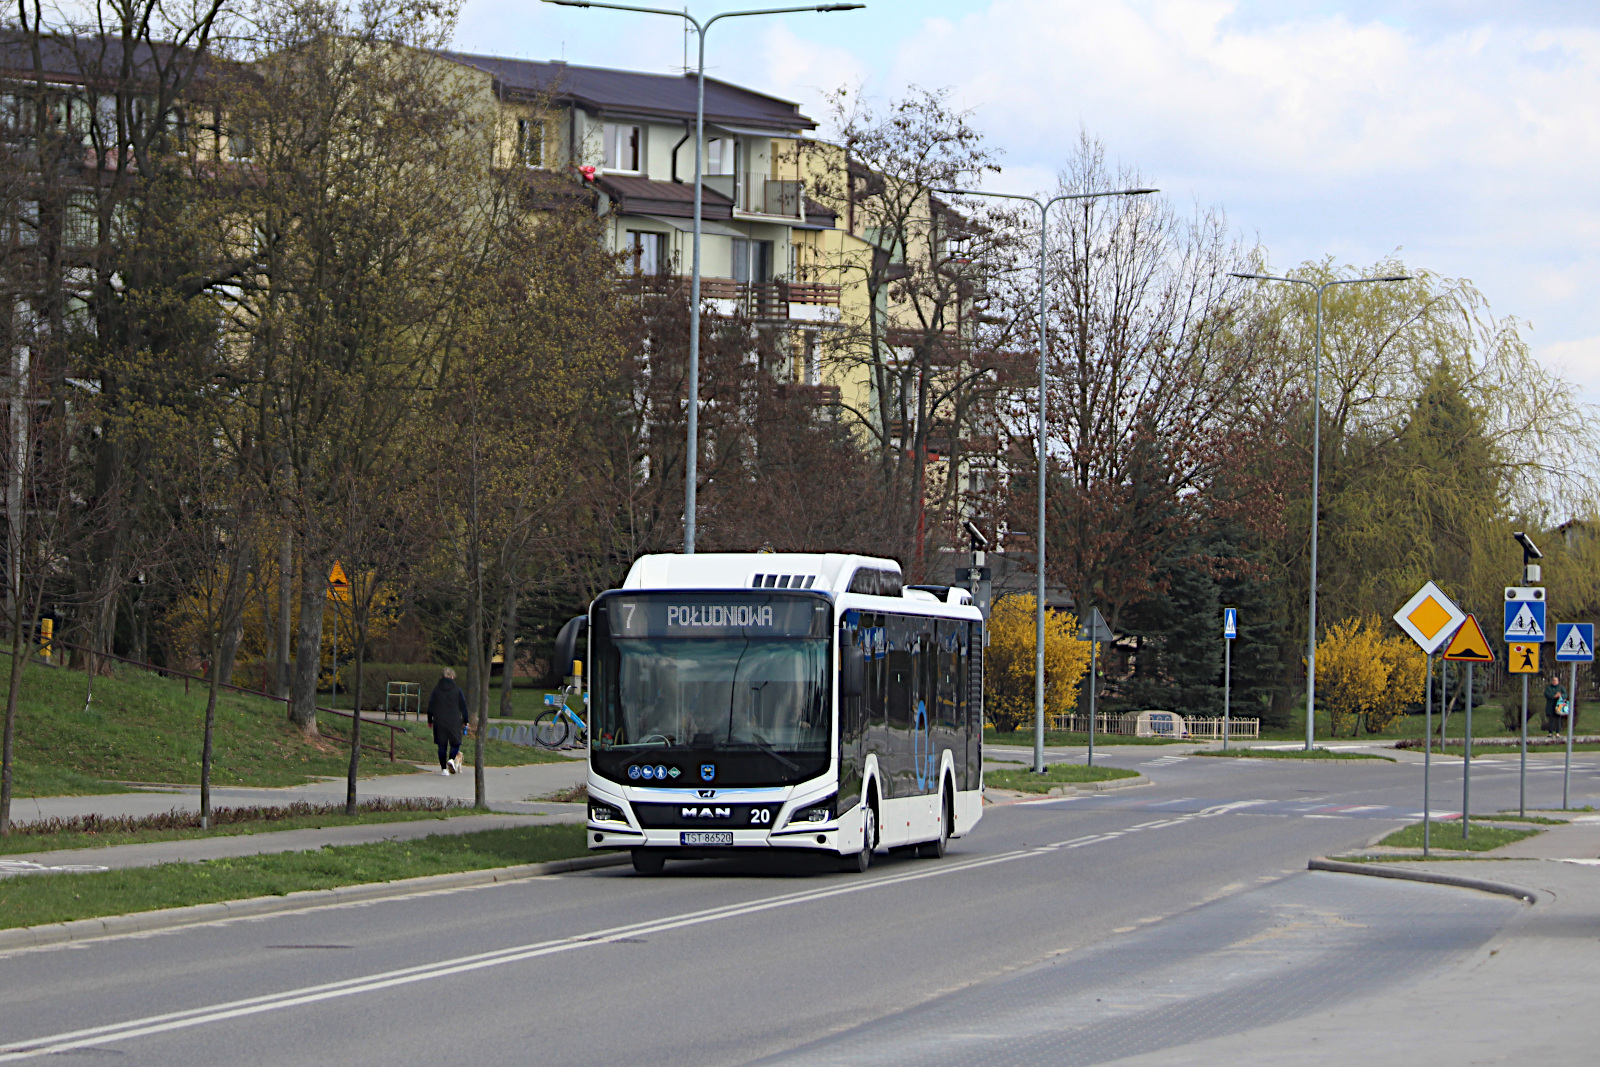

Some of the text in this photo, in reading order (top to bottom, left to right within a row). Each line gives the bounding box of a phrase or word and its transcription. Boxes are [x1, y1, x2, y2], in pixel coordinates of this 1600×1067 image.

[622, 603, 773, 629] 7 POŁUDNIOWA
[682, 807, 731, 818] MAN
[750, 809, 770, 824] 20
[686, 833, 731, 843] TST 86520
